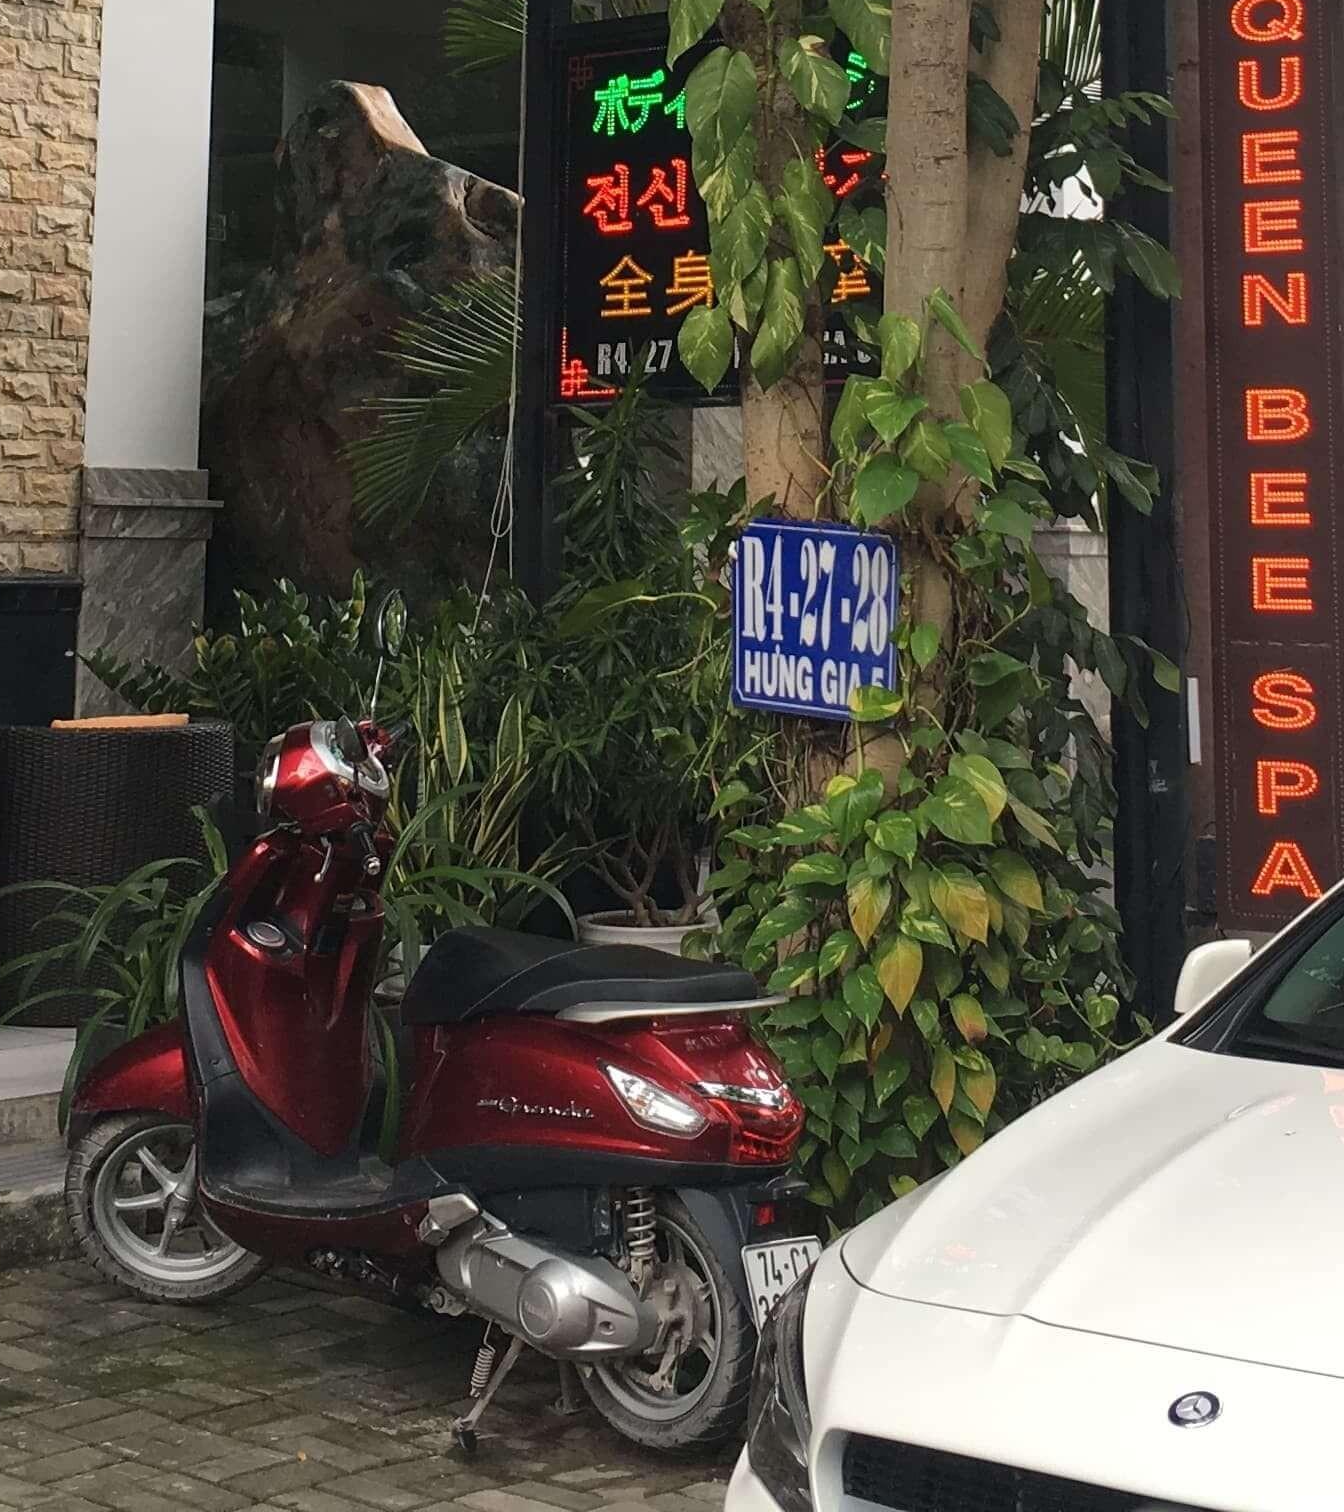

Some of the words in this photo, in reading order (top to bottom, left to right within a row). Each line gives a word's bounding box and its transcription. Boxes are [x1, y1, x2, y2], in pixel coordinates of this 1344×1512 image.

[1244, 388, 1315, 612] BEE
[744, 644, 814, 702] HƯNG
[1250, 671, 1324, 900] SPA
